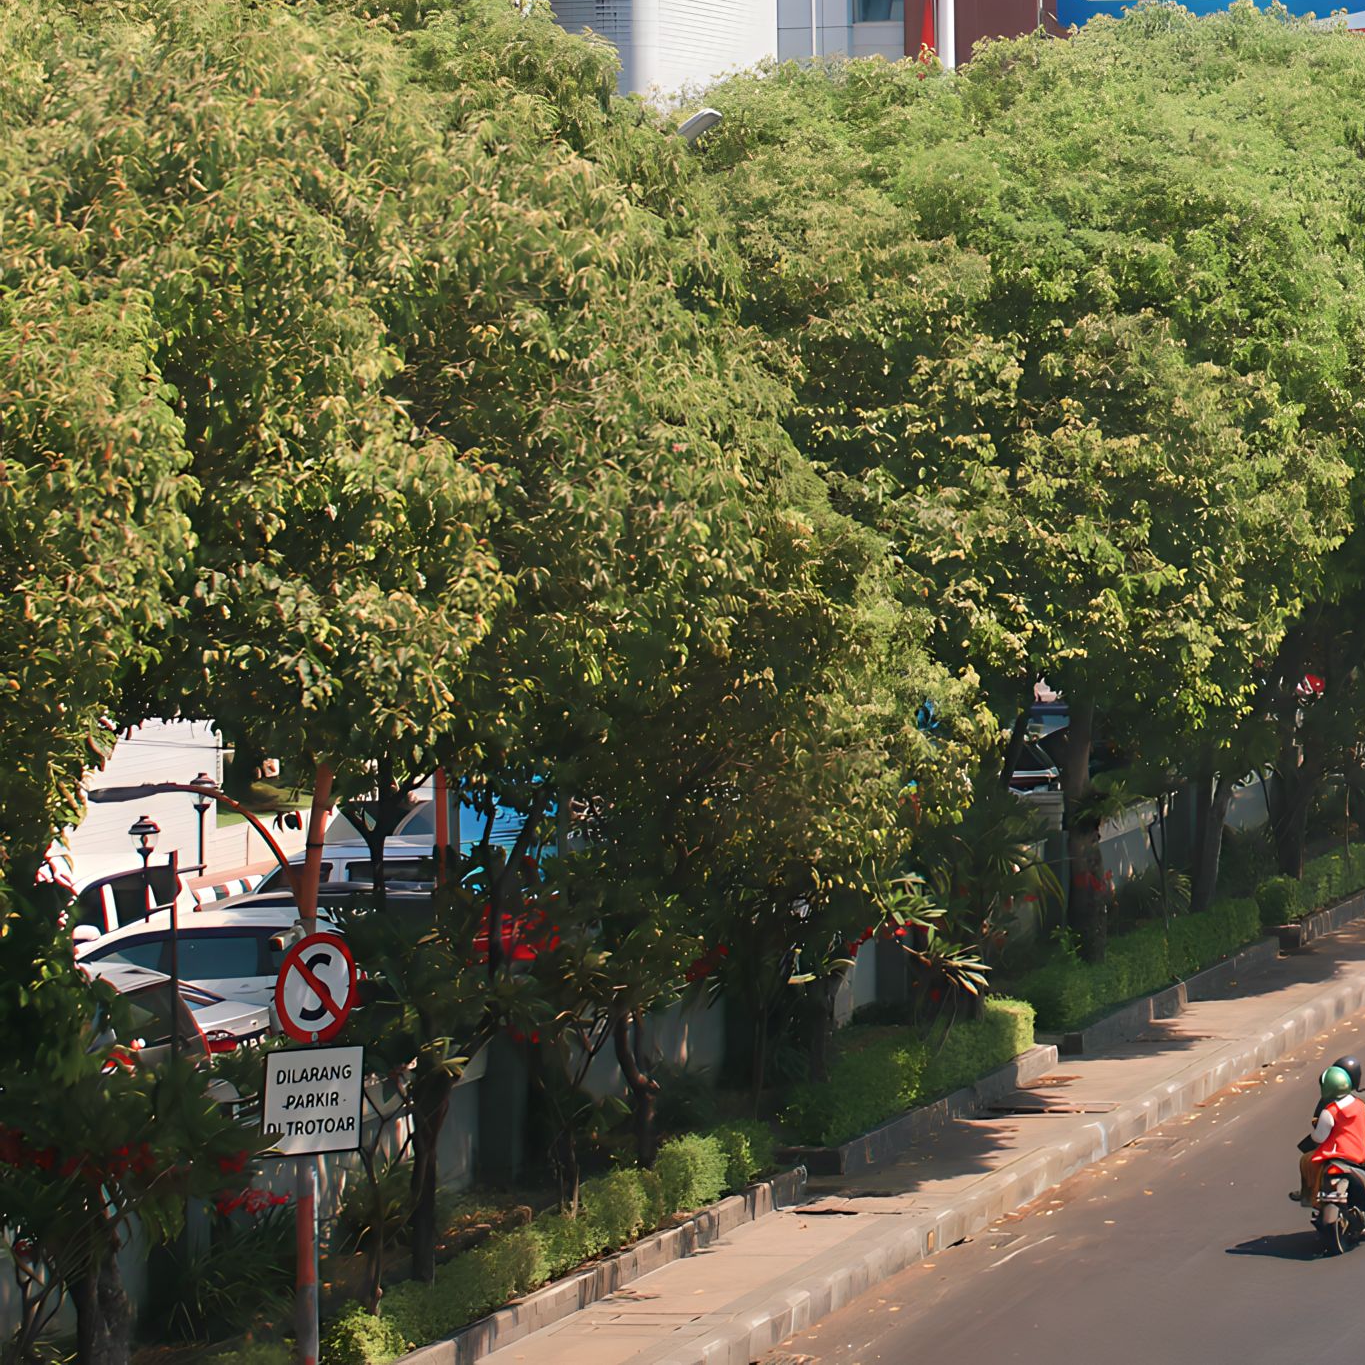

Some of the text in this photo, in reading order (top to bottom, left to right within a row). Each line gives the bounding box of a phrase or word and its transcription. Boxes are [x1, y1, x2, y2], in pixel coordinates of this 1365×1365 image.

[276, 1064, 352, 1085] DILARANG
[284, 1091, 339, 1110] PARKIR
[286, 1116, 355, 1136] TROTOAR
